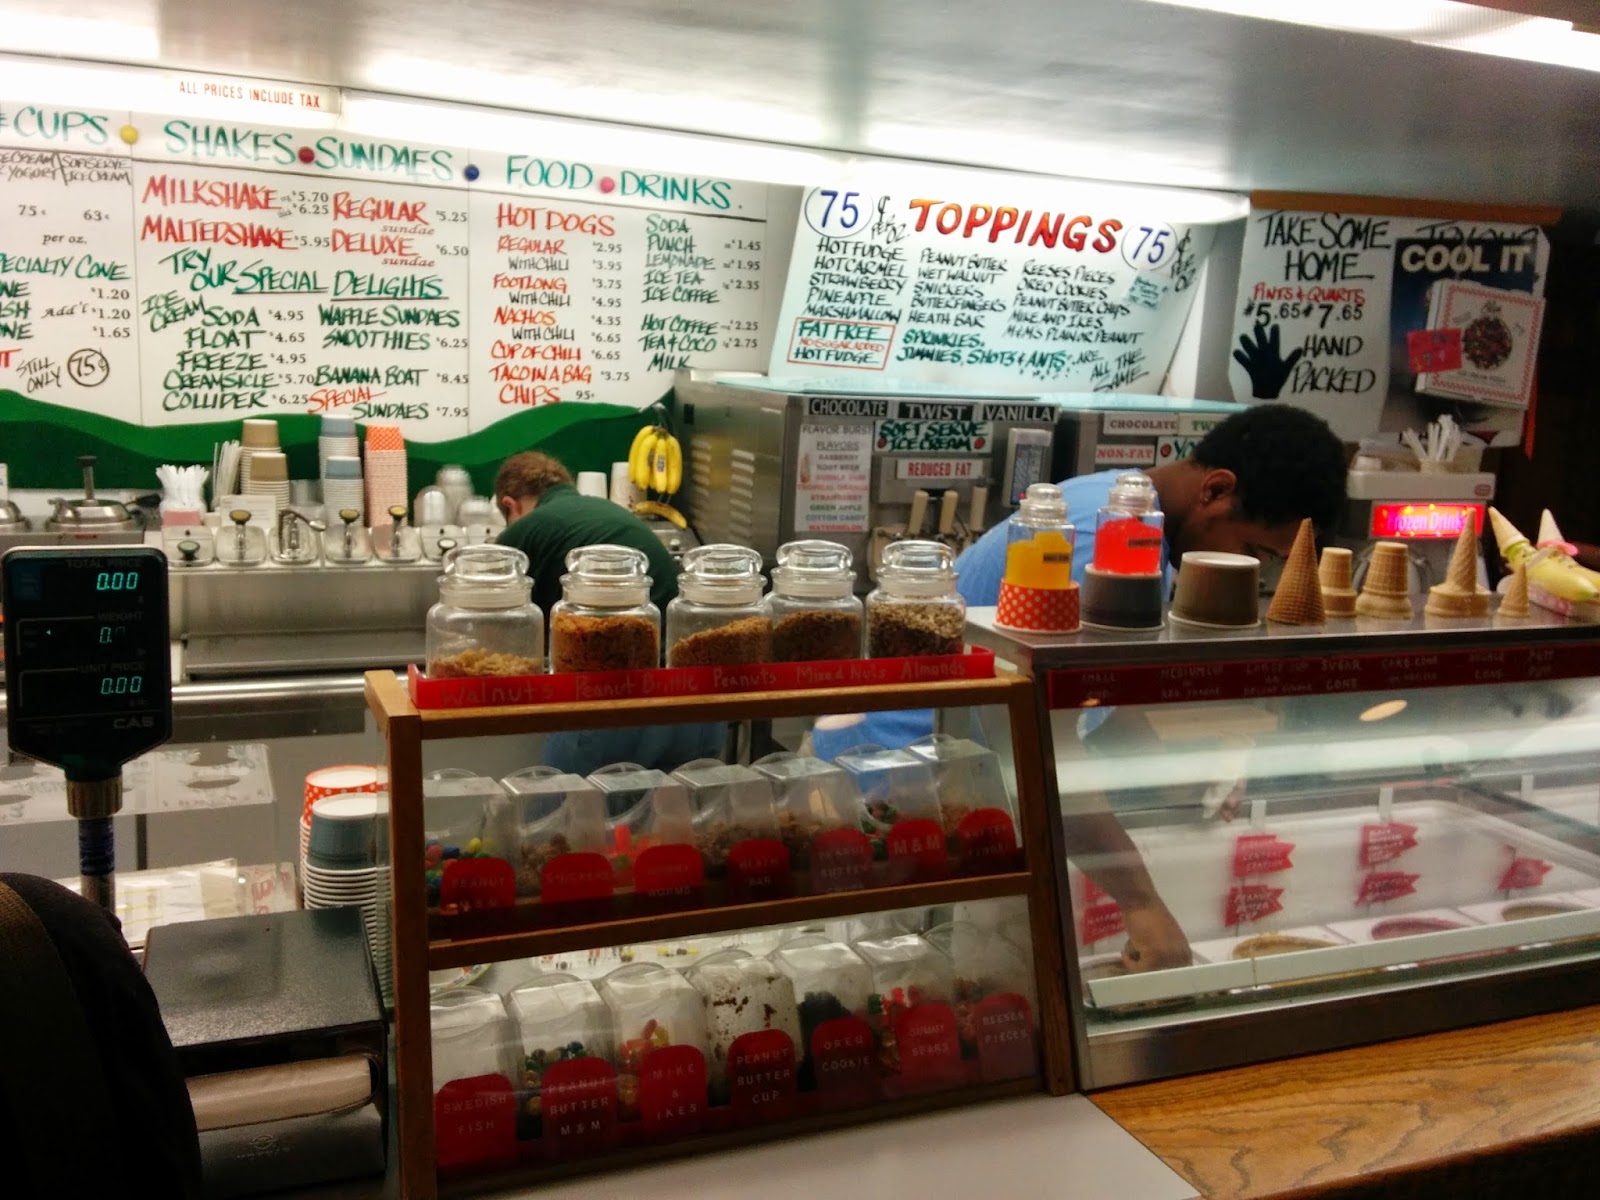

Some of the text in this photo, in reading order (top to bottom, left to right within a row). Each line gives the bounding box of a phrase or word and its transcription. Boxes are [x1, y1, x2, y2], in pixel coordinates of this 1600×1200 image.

[179, 81, 321, 109] ALL PRICES INCLUDE TAX
[13, 106, 109, 145] CUPS
[163, 119, 454, 181] SHAKES SUNDAES
[142, 174, 282, 210] MILKSHAKE
[506, 155, 732, 210] FOOD DRINKS
[333, 191, 429, 225] REGULAR
[820, 189, 860, 229] 75
[381, 225, 435, 236] sundae
[496, 202, 616, 237] HOT DOGS
[645, 213, 691, 235] SODA
[908, 198, 1123, 254] TOPPINGS
[1257, 209, 1318, 248] TAKE
[1318, 211, 1392, 251] SOME
[42, 233, 65, 245] per
[331, 228, 420, 257] DELUXE
[497, 234, 568, 255] REGULAR
[648, 233, 697, 254] PUNCH
[816, 236, 908, 262] HOT FUDGE
[1132, 226, 1170, 265] 75
[75, 254, 132, 281] CONE
[382, 256, 436, 267] sundae
[644, 253, 716, 271] LEMONADE
[814, 255, 848, 270] HOT
[1284, 250, 1375, 283] HOME
[1401, 244, 1532, 273] COOL IT
[158, 246, 443, 299] TRY OUR SPECIAL DELIGHTS
[643, 269, 705, 286] ICE TEA
[918, 267, 946, 280] WET
[641, 285, 720, 304] ICE COFFEE
[1253, 281, 1293, 301] PINTS
[200, 305, 261, 327] SODA
[318, 303, 461, 328] WAFFLE SUNDAES
[493, 305, 557, 326] NACHOS
[640, 313, 719, 335] HOT COFFEE
[184, 326, 267, 349] FLOAT
[322, 327, 431, 351] SMOOTHIES
[511, 326, 541, 341] WITH
[543, 325, 575, 341] CHILI
[638, 332, 666, 352] TEA
[798, 320, 892, 342] FAT FREE
[491, 339, 522, 360] CUP
[541, 344, 582, 361] CHILI
[794, 346, 880, 364] HOT FUDGE
[1302, 333, 1364, 358] HAND
[16, 356, 55, 378] STILL
[176, 350, 268, 372] FREEZE
[646, 352, 694, 372] MILK
[27, 366, 62, 393] ONLY
[313, 364, 381, 387] BANANA
[384, 365, 429, 388] BOAT
[488, 362, 530, 382] TACO
[550, 365, 560, 382] A
[562, 364, 592, 384] BAG
[1292, 360, 1376, 394] PACKED
[162, 389, 269, 412] COLLIDER
[307, 386, 388, 414] SPECIAL
[498, 383, 561, 406] CHIPS
[351, 400, 430, 420] SUNDAES
[810, 399, 1051, 422] CHOCOLATE TWIST VANILLA
[880, 419, 988, 437] SOFT SERVE
[1109, 419, 1177, 430] CHOCOLATE
[1095, 448, 1153, 460] NON-FAT
[907, 461, 973, 477] REDUCED FAT
[96, 572, 139, 591] 0.00
[100, 676, 142, 695] 0.00
[550, 1097, 609, 1115] BUTTER
[751, 1090, 780, 1105] CUP
[457, 1120, 495, 1135] FISH
